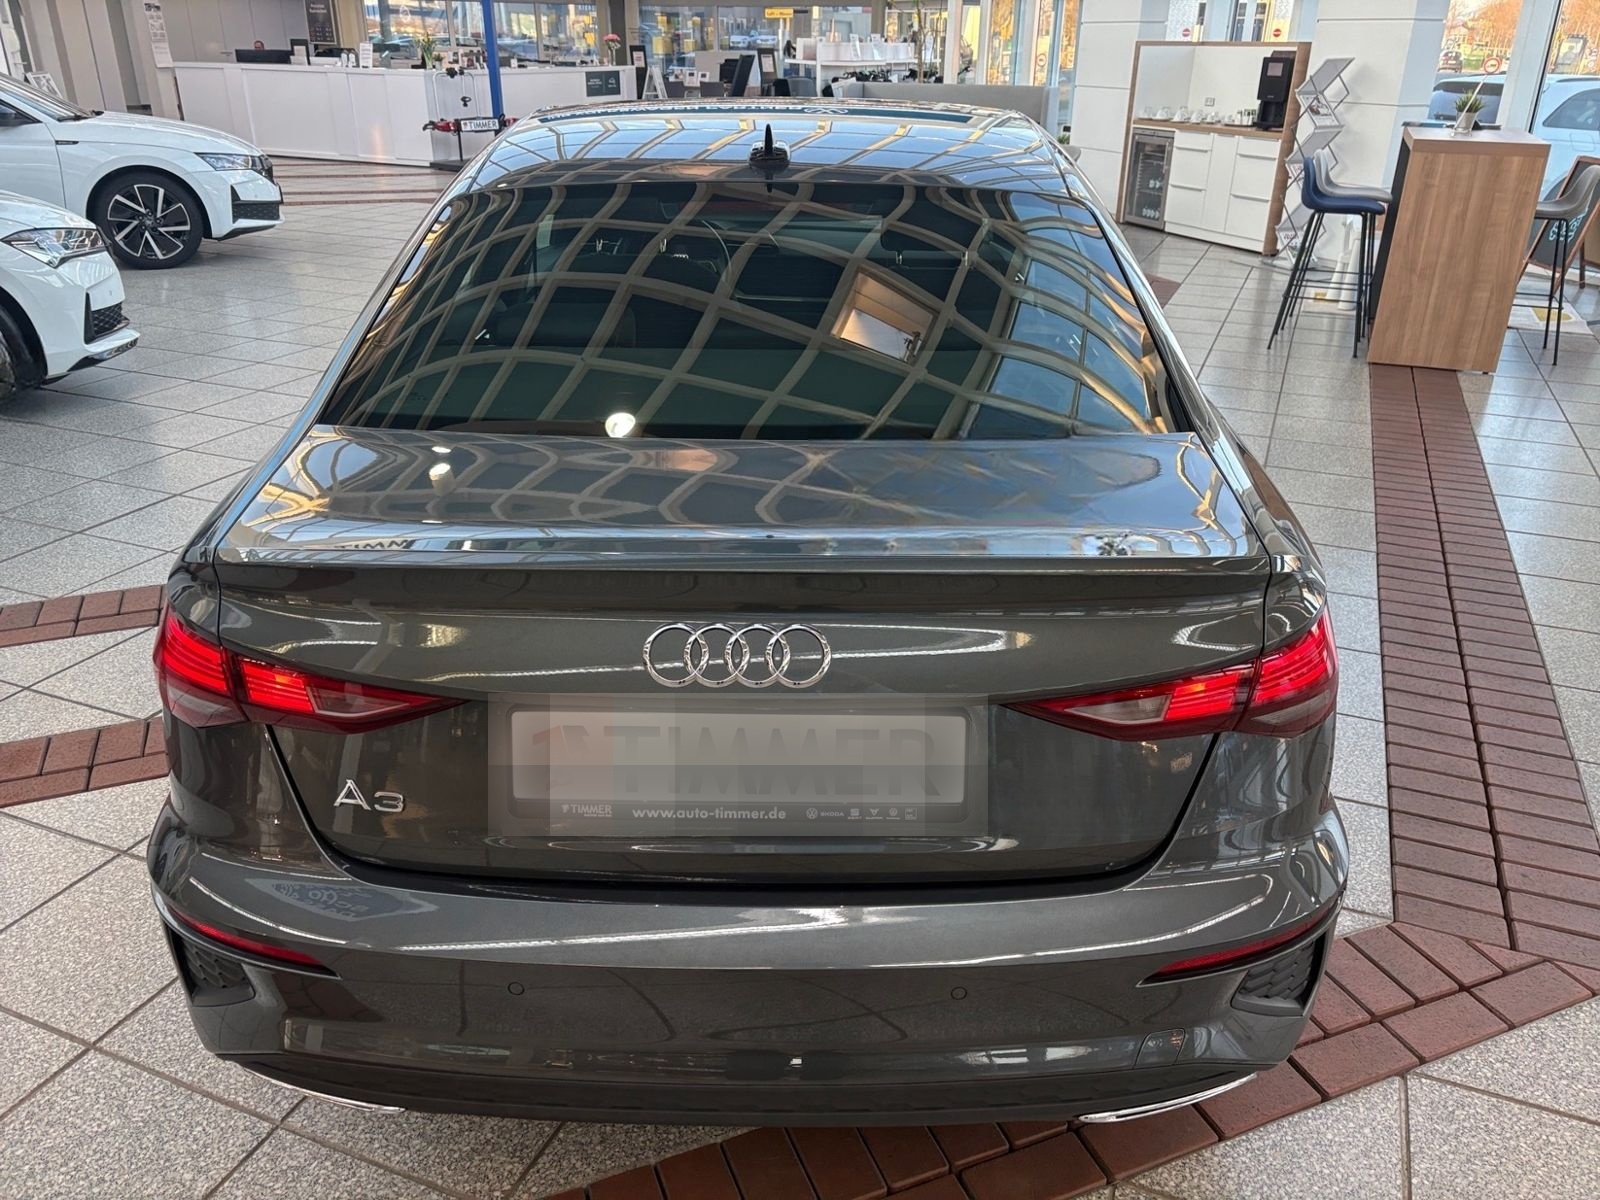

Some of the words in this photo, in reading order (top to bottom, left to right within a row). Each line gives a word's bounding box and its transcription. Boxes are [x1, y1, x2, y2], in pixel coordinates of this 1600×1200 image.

[468, 119, 498, 129] TIMMER
[603, 725, 941, 796] TIMMER
[333, 779, 404, 813] A3
[570, 803, 613, 814] TIMMER
[631, 807, 787, 820] www.auto-timmer.de
